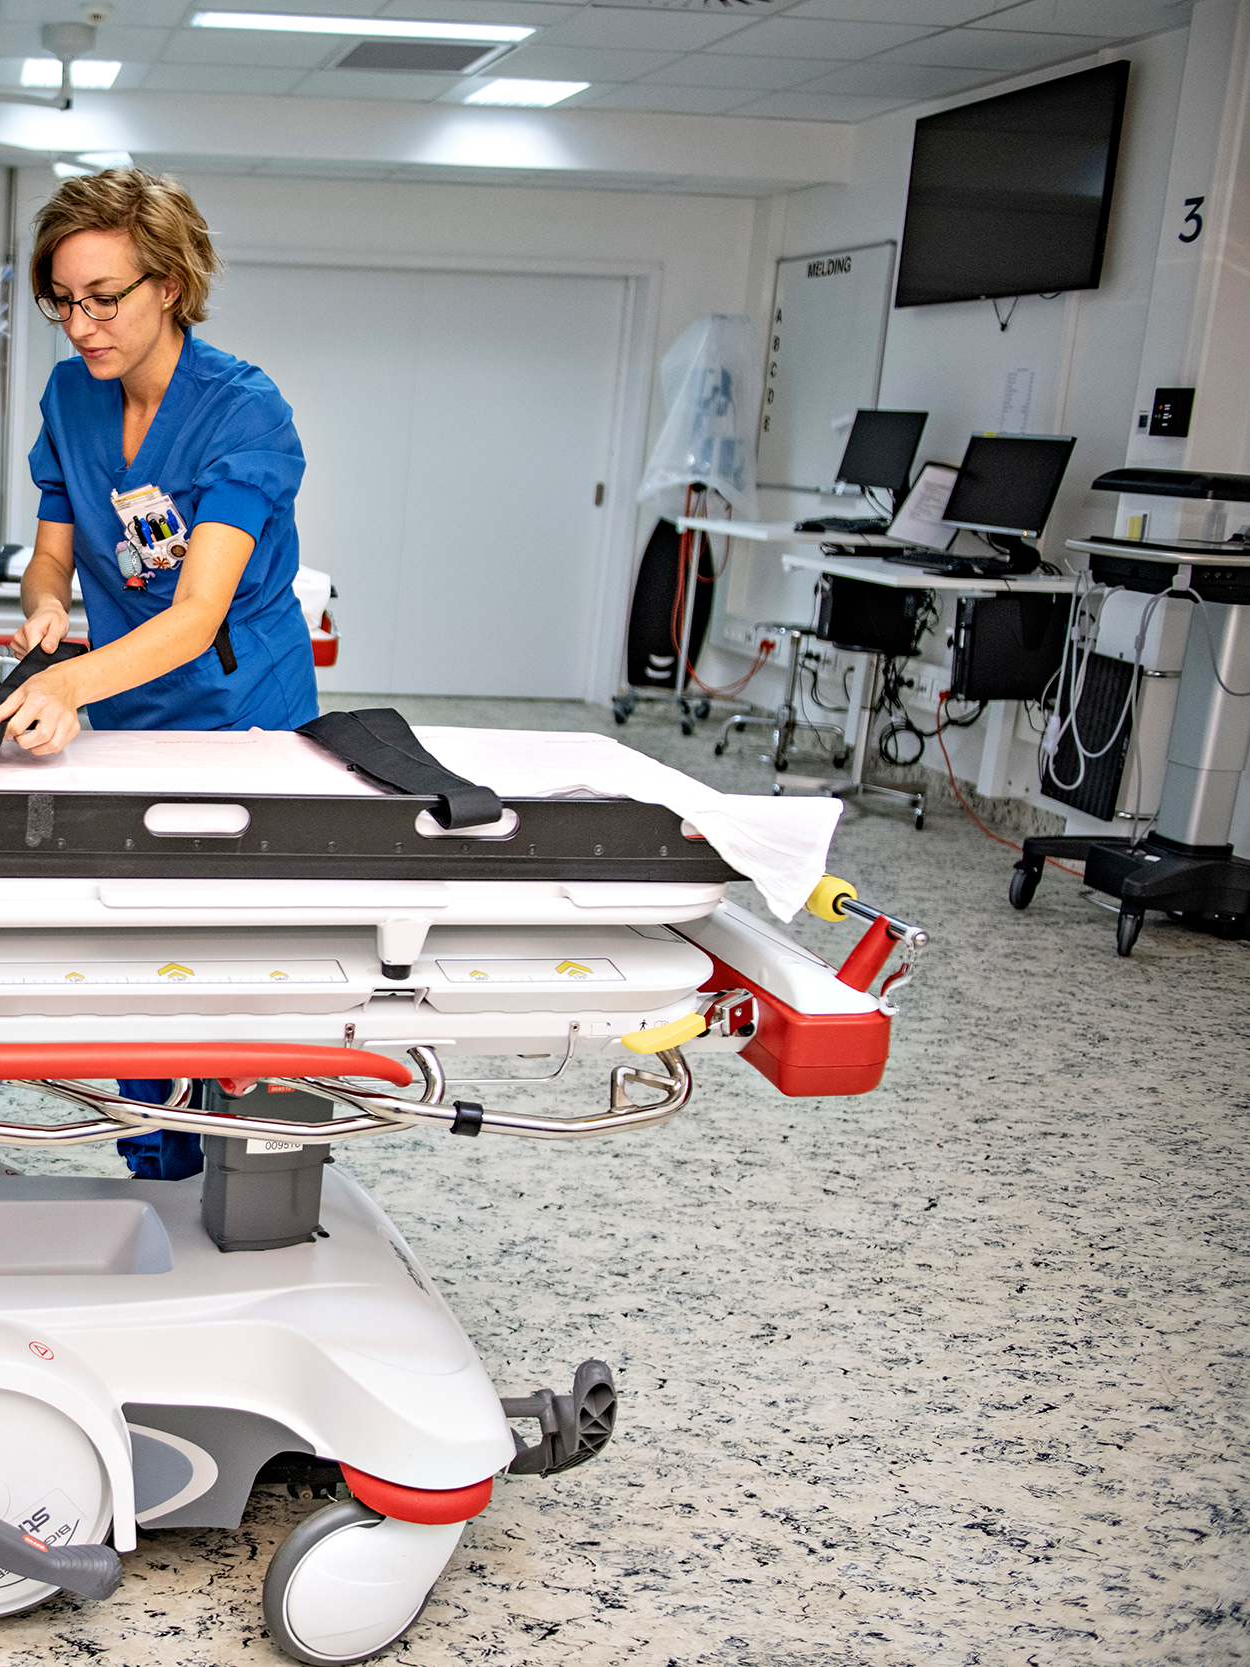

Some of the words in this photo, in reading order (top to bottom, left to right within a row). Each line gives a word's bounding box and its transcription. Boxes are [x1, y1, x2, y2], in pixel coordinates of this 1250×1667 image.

[1178, 196, 1205, 243] 3
[807, 256, 852, 278] MELDING
[775, 307, 783, 324] A
[773, 335, 781, 352] B
[770, 361, 778, 378] C
[767, 388, 775, 404] D
[764, 416, 771, 432] E
